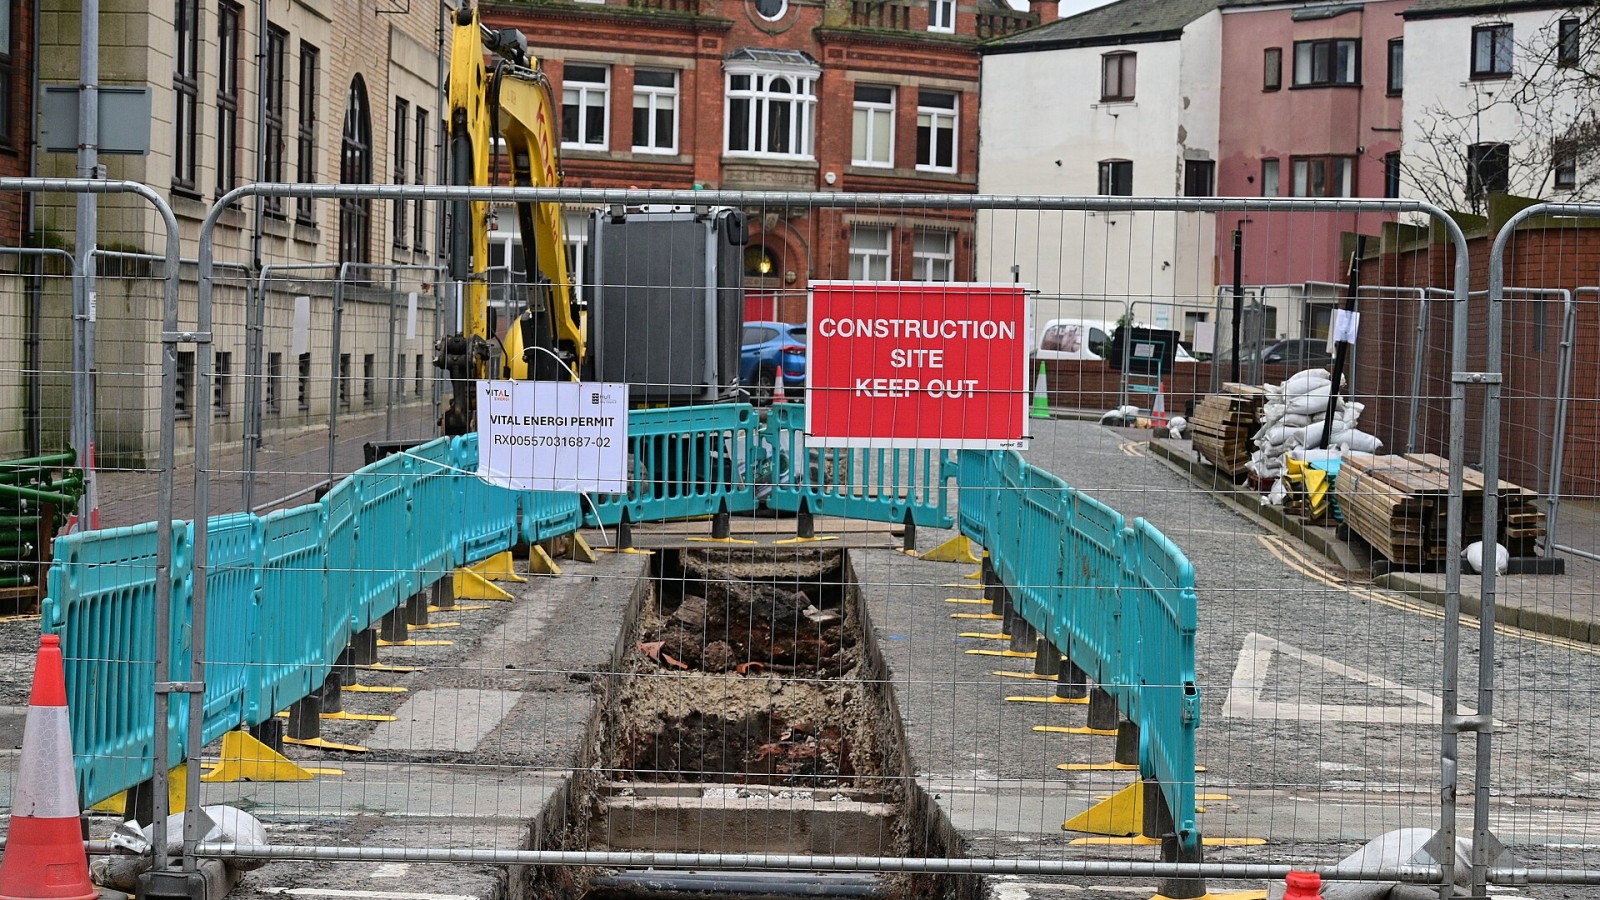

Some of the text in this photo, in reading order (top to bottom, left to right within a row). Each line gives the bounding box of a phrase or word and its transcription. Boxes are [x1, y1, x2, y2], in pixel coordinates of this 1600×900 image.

[819, 318, 1015, 339] CONSTRUCTION
[890, 348, 944, 368] SITE
[485, 389, 509, 397] VITAL
[855, 378, 979, 399] KEEP OUT
[490, 415, 615, 427] VITAL ENERGI PERMIT
[494, 435, 611, 447] RX00557031687-02
